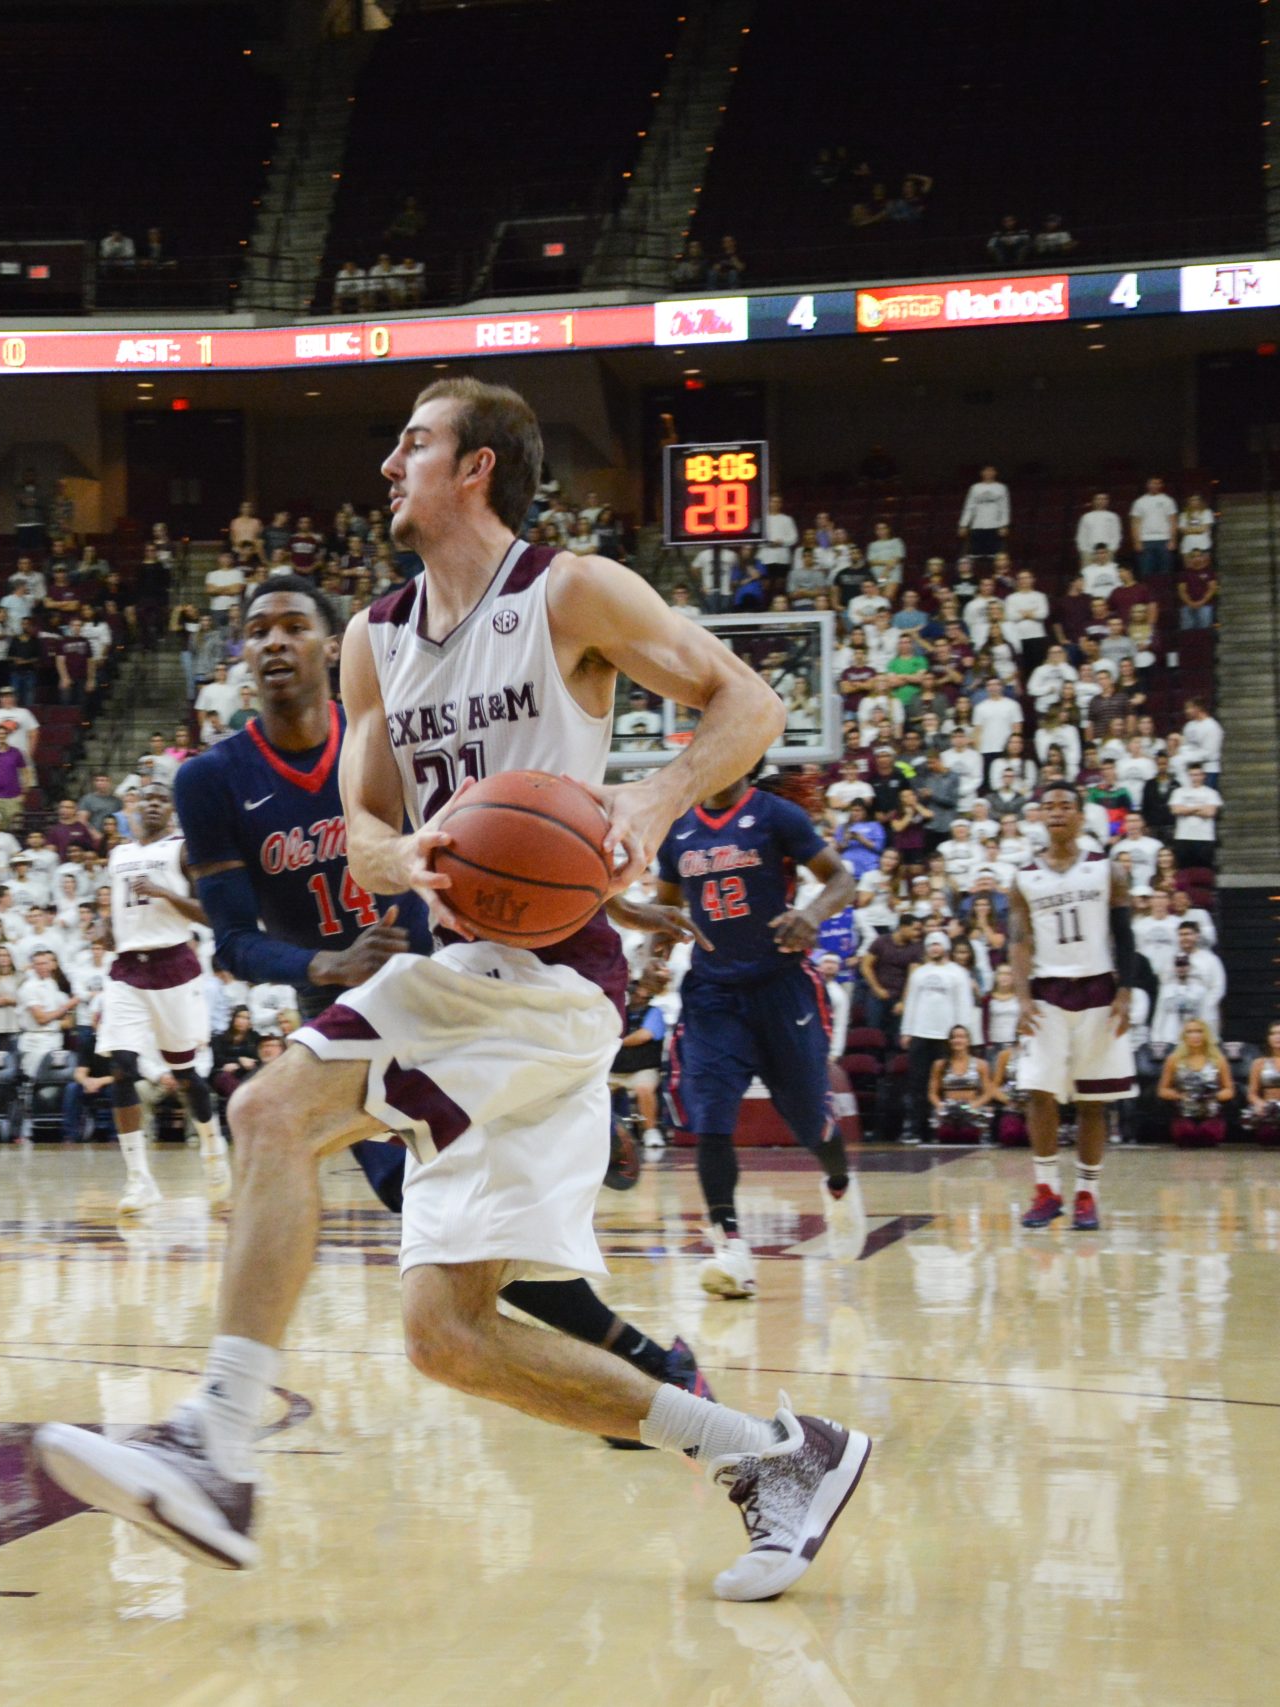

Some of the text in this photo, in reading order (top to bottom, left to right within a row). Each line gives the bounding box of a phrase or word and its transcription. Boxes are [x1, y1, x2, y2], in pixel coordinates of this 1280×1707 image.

[944, 282, 1065, 321] Nachos!
[1108, 272, 1141, 310] 4
[476, 315, 576, 348] REB: 1
[787, 295, 818, 331] 4
[1, 338, 26, 367] 0
[116, 335, 213, 365] AST: 1
[295, 327, 390, 358] BLK: 0
[685, 452, 757, 482] 18:06
[684, 483, 749, 535] 28
[494, 612, 518, 633] SEC
[387, 680, 540, 748] EXAS A&M
[260, 826, 316, 875] Ole
[307, 865, 380, 937] 14
[701, 875, 751, 921] 42
[1054, 907, 1084, 944] 11
